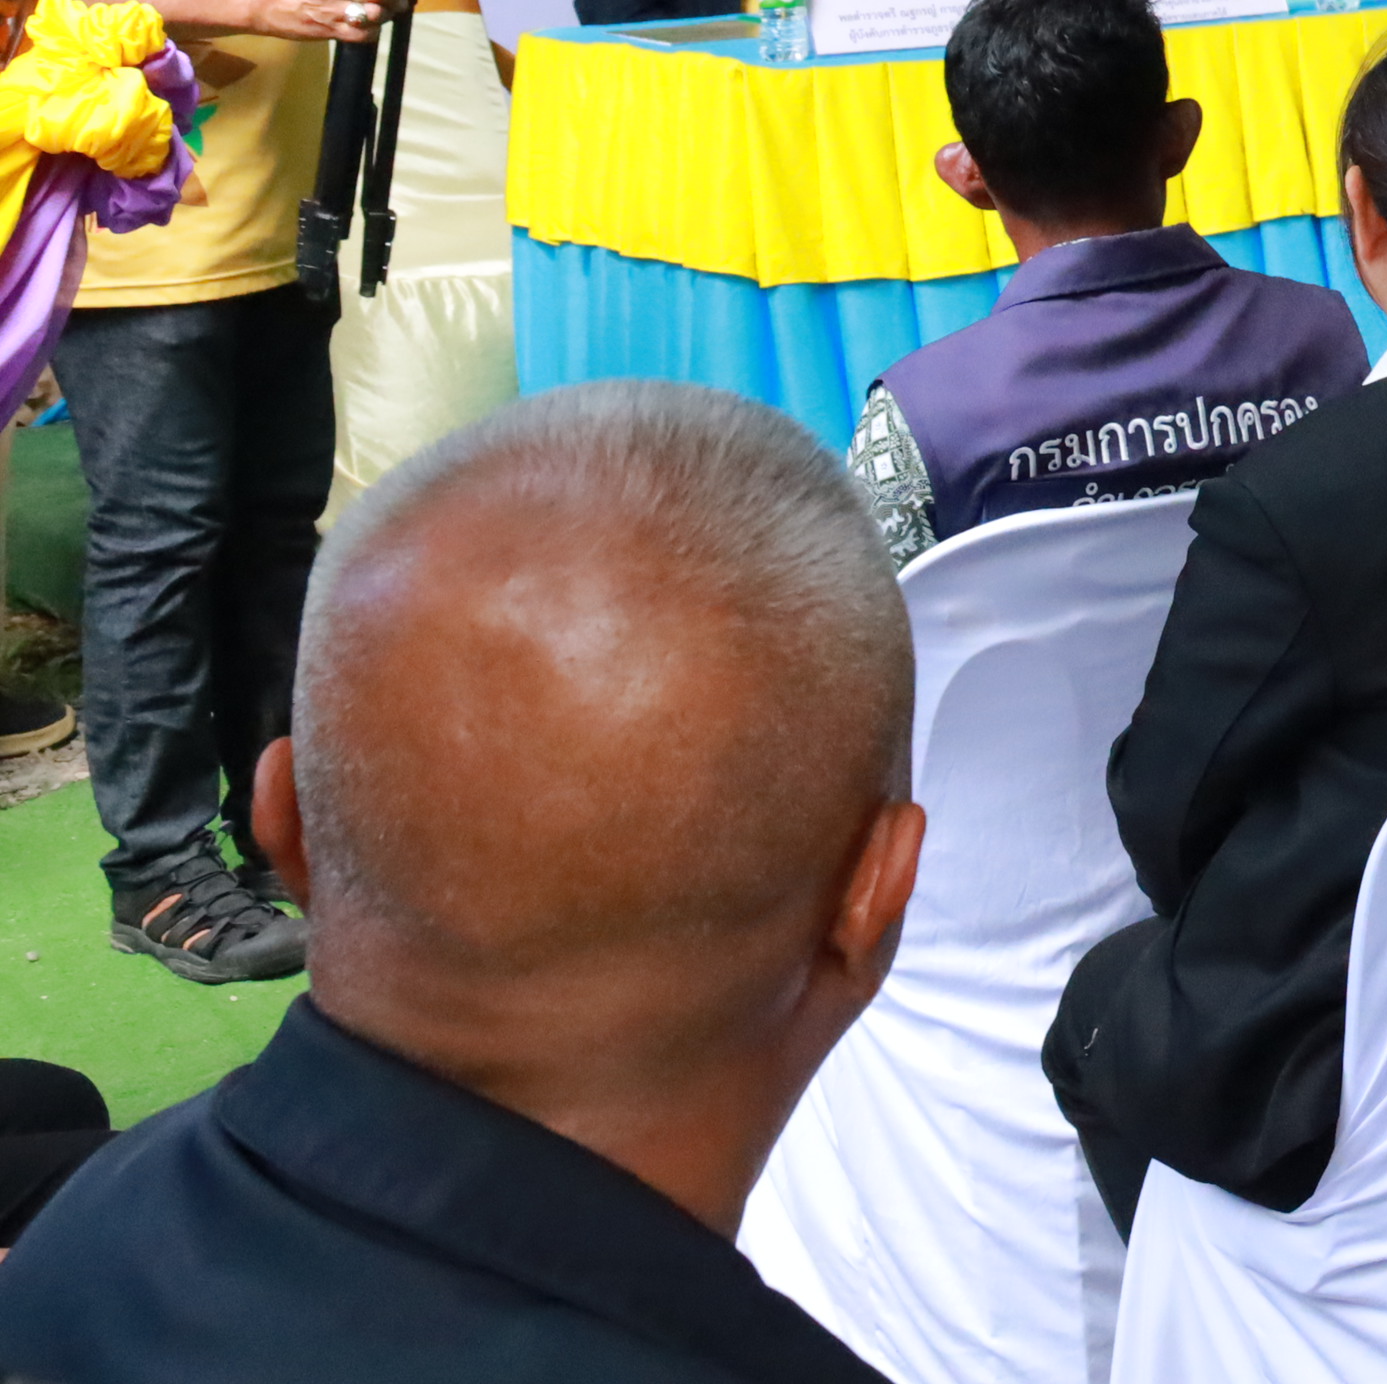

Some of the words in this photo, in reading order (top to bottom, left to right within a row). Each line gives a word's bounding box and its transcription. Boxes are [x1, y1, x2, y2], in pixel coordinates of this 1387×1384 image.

[1009, 396, 1318, 481] กรมการปกครอ
